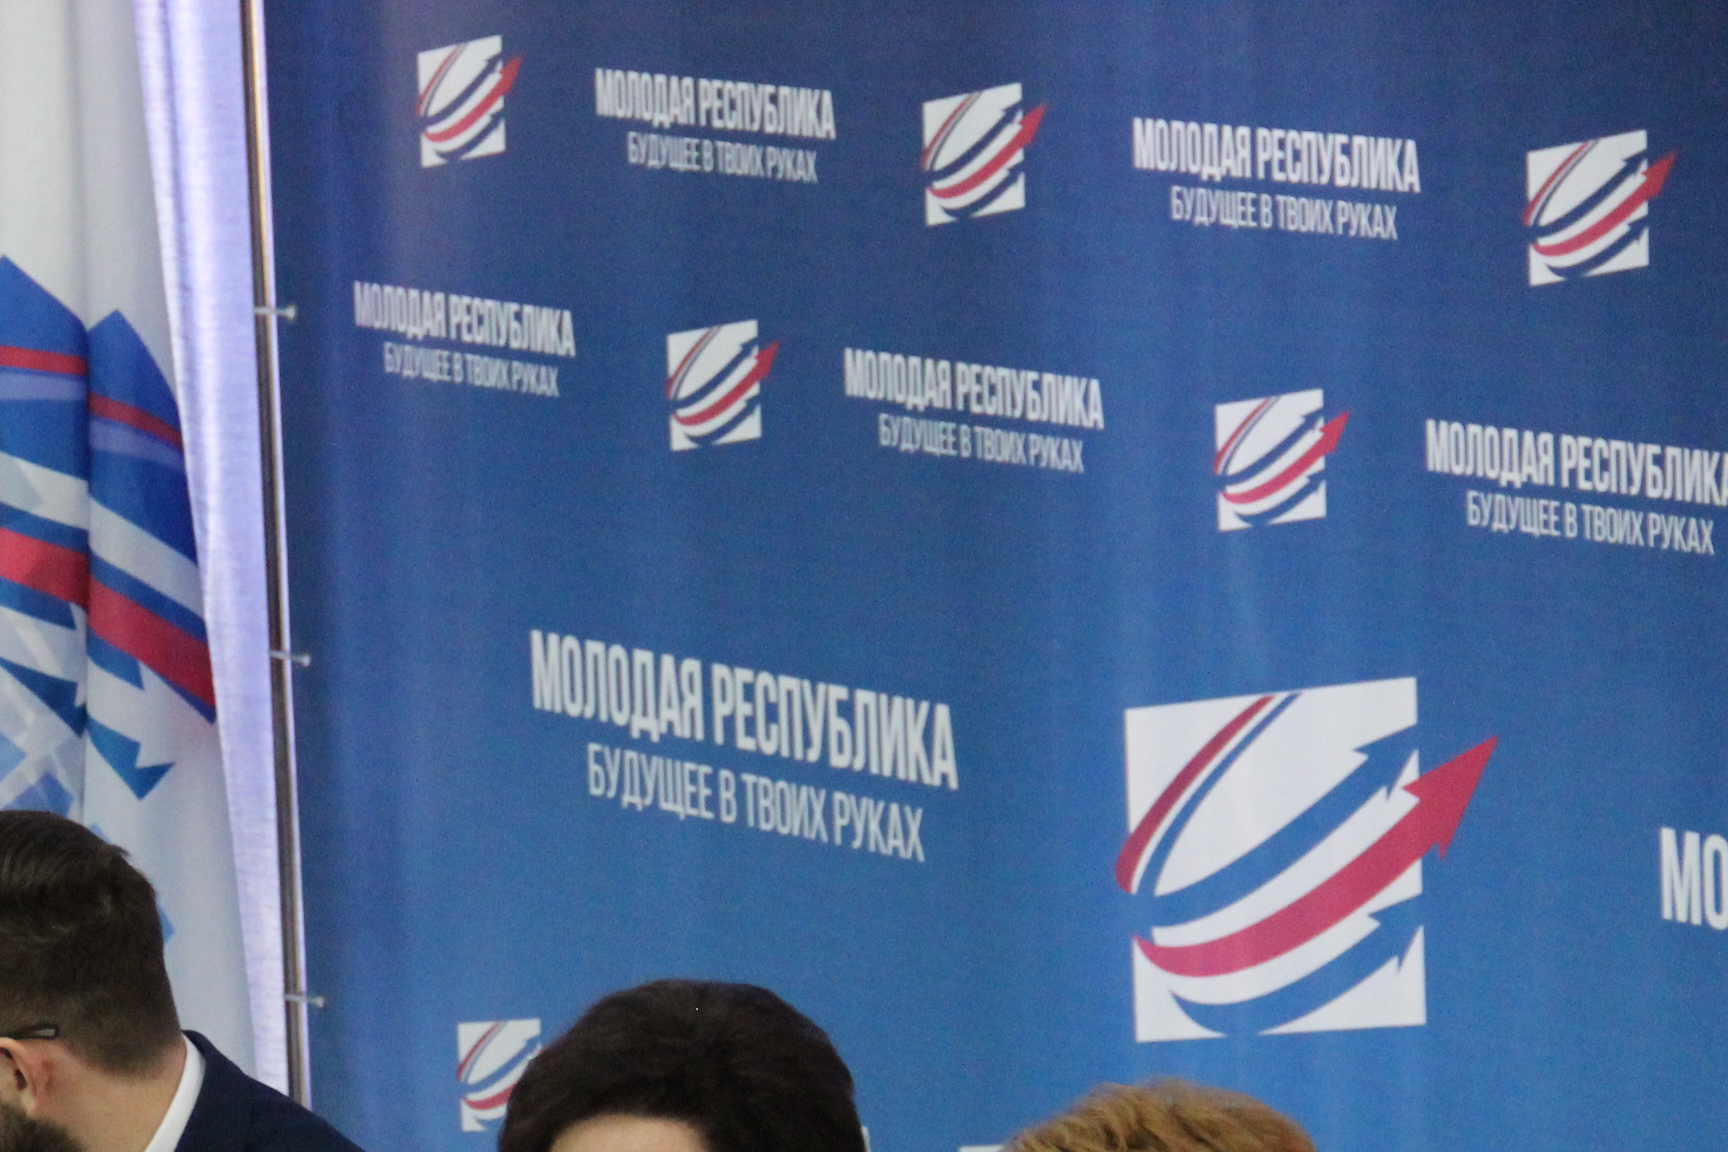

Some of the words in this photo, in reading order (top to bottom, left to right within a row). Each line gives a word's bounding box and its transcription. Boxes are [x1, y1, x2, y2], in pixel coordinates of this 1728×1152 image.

[595, 68, 695, 129] МОЛОДАЯ
[697, 78, 836, 140] РЕСПУБЛИКА
[627, 131, 700, 172] БУДУЩЕЕ
[702, 139, 713, 172] В
[715, 140, 765, 177] ТВОИХ
[765, 146, 818, 182] РУКАХ
[1132, 117, 1252, 182] МОЛОДАЯ
[1255, 127, 1421, 193] РЕСПУБЛИКА
[1170, 185, 1258, 229] БУДУЩЕЕ
[1259, 194, 1273, 229] В
[1275, 195, 1334, 234] ТВОИХ
[1336, 200, 1398, 240] РУКАХ
[353, 280, 447, 341] МОЛОДАЯ
[448, 294, 576, 358] РЕСПУБЛИКА
[384, 342, 452, 383] БУДУЩЕЕ
[453, 351, 463, 384] В
[465, 353, 512, 391] ТВОИХ
[512, 360, 559, 397] РУКАХ
[843, 347, 952, 412] МОЛОДАЯ
[955, 361, 1104, 430] РЕСПУБЛИКА
[879, 413, 958, 456] БУДУЩЕЕ
[959, 424, 972, 458] В
[973, 426, 1027, 465] ТВОИХ
[1028, 433, 1084, 473] РУКАХ
[1425, 418, 1555, 489] МОЛОДАЯ
[1466, 490, 1561, 538] БУДУЩЕЕ
[1563, 502, 1578, 538] В
[1580, 504, 1645, 546] ТВОИХ
[1647, 512, 1714, 555] РУКАХ
[530, 629, 704, 742] МОЛОДАЯ
[711, 663, 958, 790] РЕСПУБЛИКА
[588, 743, 714, 820] БУДУЩЕЕ
[719, 769, 737, 823] В
[741, 773, 828, 843] ТВОИХ
[832, 791, 925, 862] РУКАХ
